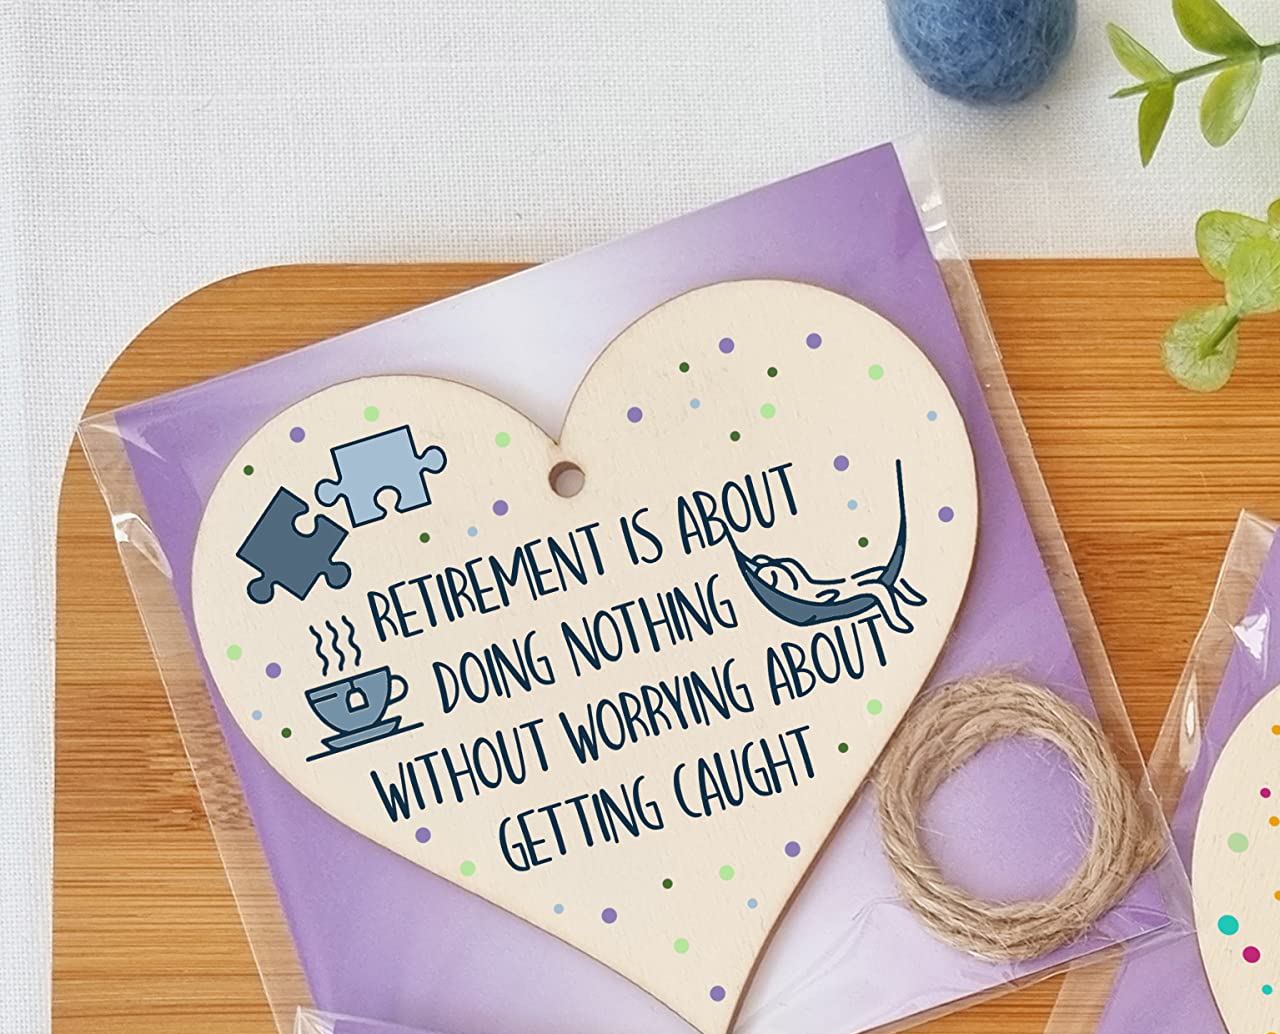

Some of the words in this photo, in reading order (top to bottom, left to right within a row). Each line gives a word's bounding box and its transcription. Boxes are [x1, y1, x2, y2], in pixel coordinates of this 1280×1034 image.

[366, 522, 605, 643] RETIREMENT
[619, 507, 663, 566] IS
[677, 462, 798, 554] ABOUT
[369, 719, 549, 823] WITHOUT
[558, 658, 755, 764] WORRYING
[766, 613, 887, 706] ABOUT
[432, 630, 556, 714] DOING
[560, 573, 739, 677] NOTHING
[499, 775, 665, 872] GETTING
[673, 725, 815, 818] CAUGHT
